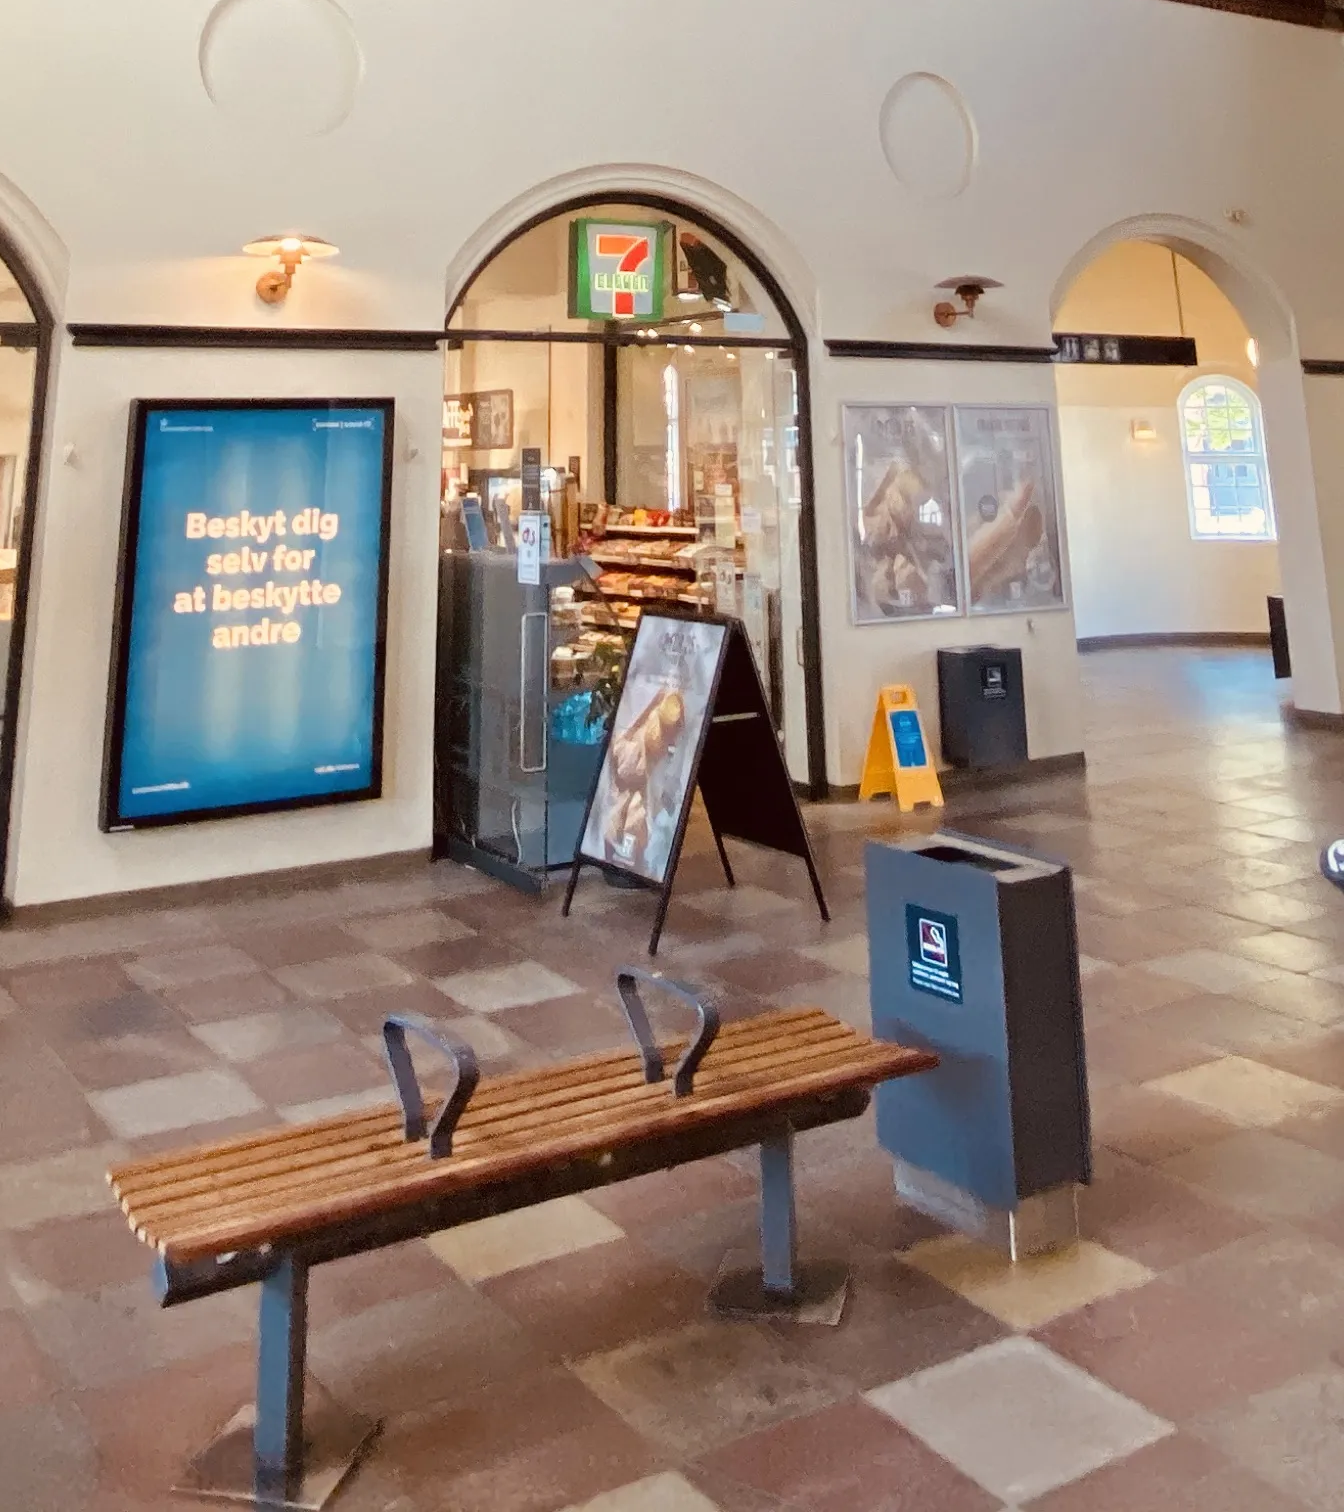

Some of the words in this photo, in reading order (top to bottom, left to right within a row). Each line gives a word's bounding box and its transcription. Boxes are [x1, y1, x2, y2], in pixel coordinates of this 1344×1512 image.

[595, 234, 649, 318] 7
[186, 510, 287, 543] Beskyt
[291, 508, 339, 540] dig
[206, 546, 268, 574] selv
[273, 544, 316, 571] for
[173, 586, 207, 613] at
[212, 579, 342, 614] beskytte
[212, 617, 302, 649] andre
